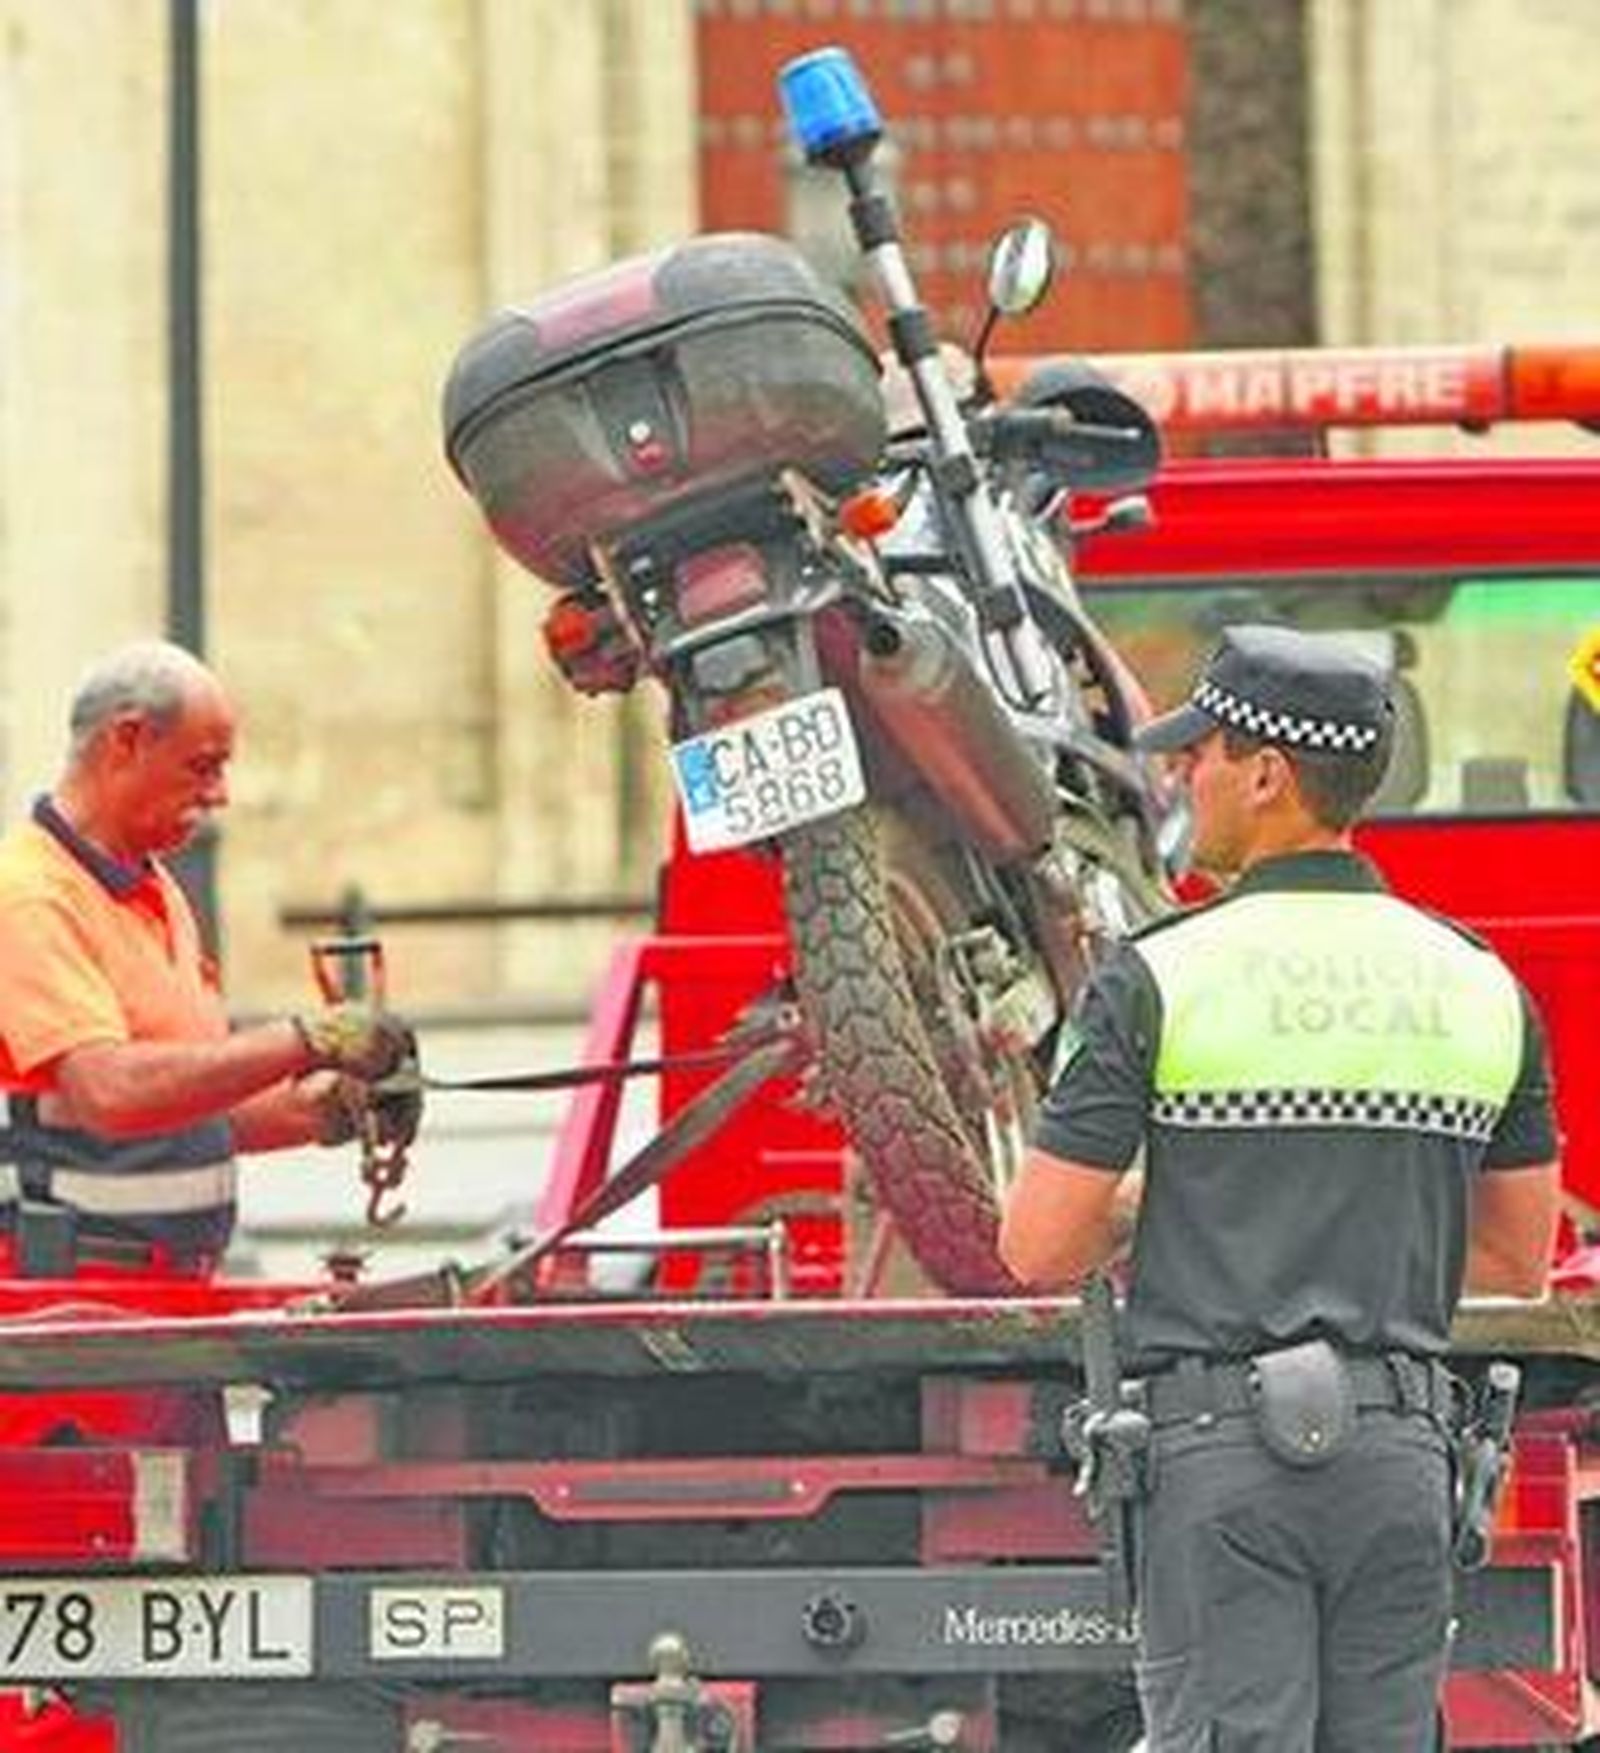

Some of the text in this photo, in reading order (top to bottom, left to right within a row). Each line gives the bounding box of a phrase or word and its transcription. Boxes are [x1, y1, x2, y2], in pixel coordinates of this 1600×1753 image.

[1190, 361, 1465, 410] MAPFRE
[726, 758, 846, 832] 5868
[1270, 994, 1452, 1037] LOCAL
[4, 1592, 95, 1663] 78
[386, 1598, 484, 1647] SP
